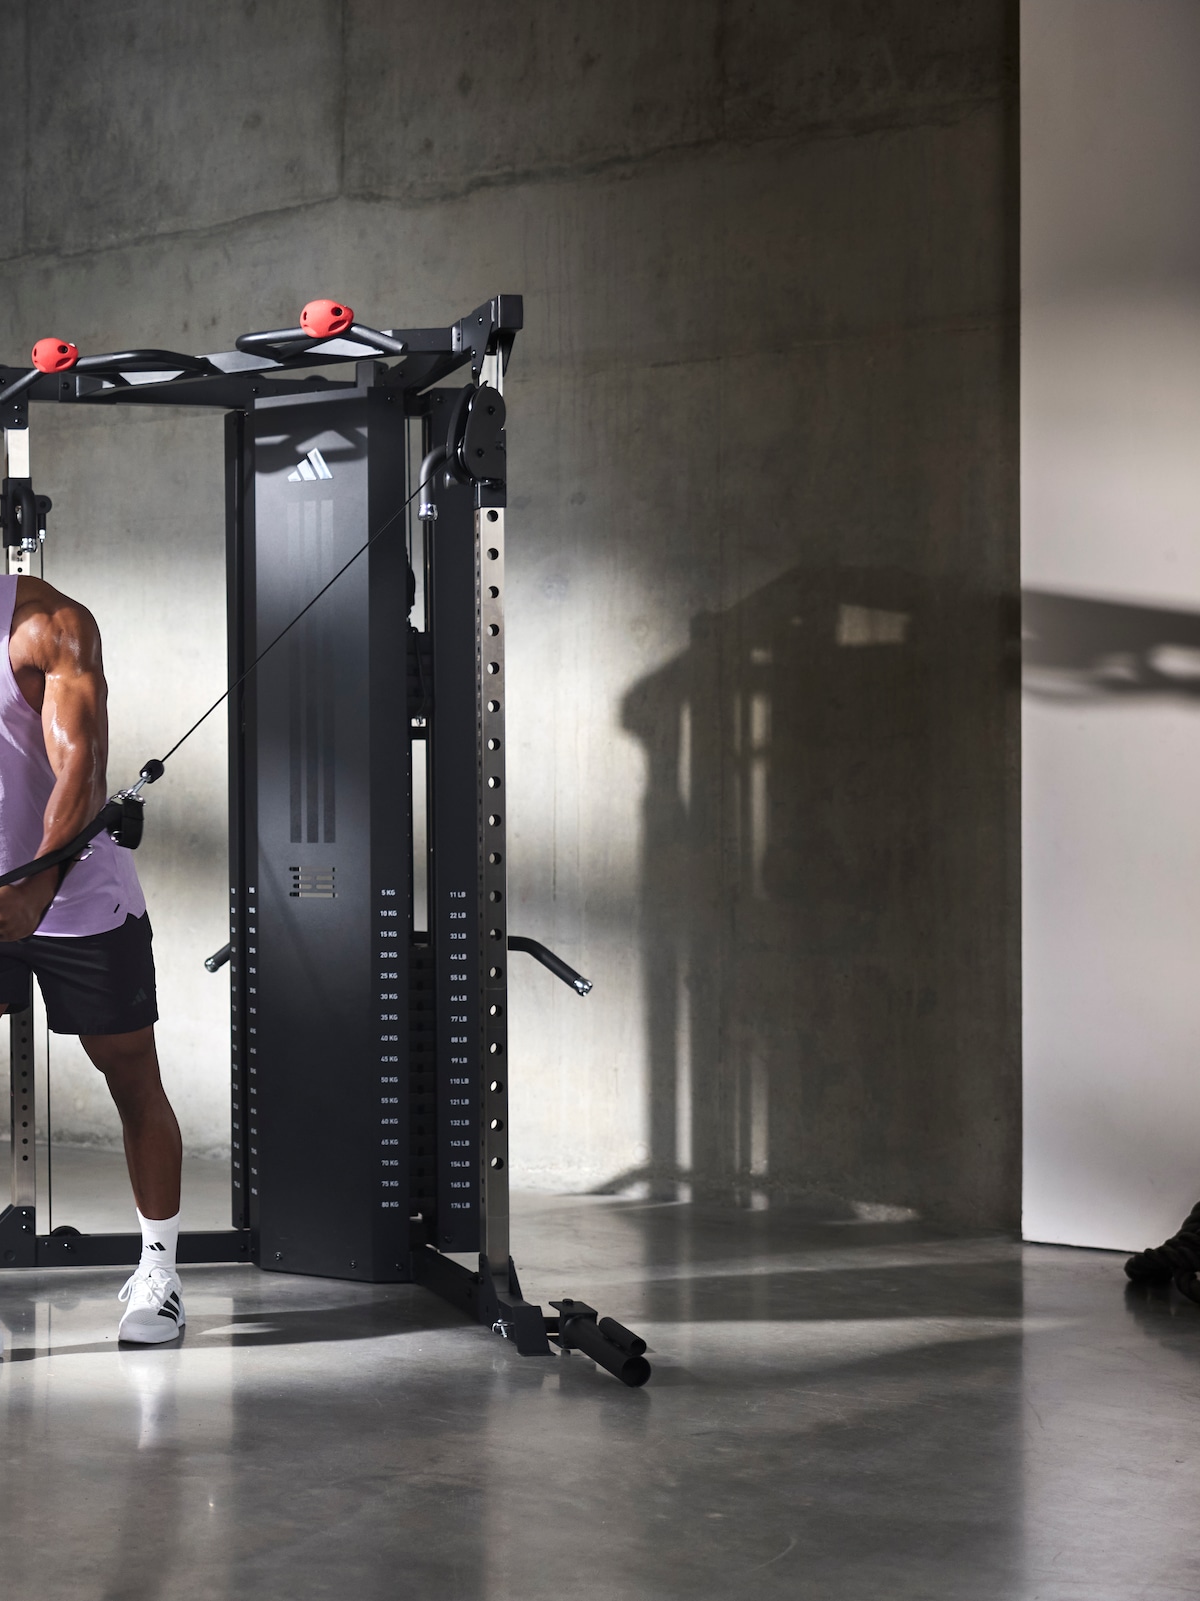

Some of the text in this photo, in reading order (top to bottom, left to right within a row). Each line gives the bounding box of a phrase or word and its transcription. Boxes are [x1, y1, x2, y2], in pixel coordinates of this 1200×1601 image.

[387, 888, 396, 897] KG
[449, 891, 467, 899] 11 LB
[380, 909, 398, 917] 10 KG
[449, 911, 467, 920] 22 LB
[380, 930, 398, 938] 15 KG
[449, 932, 467, 940] 33 LB
[380, 951, 398, 959] 20 KG
[449, 953, 467, 961] 44 LB
[380, 972, 398, 980] 25 KG
[450, 973, 467, 982] 55 LB
[380, 992, 398, 1001] 30 KG
[450, 994, 468, 1002] 66 LB
[380, 1013, 398, 1021] 35 KG
[450, 1015, 468, 1023] 77 LB
[380, 1034, 398, 1042] 40 KG
[450, 1036, 468, 1044] 88 LB
[380, 1055, 399, 1063] 45 KG
[450, 1056, 468, 1064] 99 LB
[380, 1076, 399, 1084] 50 KG
[450, 1077, 470, 1085] 110 LB
[450, 1098, 470, 1106] 121 LB
[381, 1117, 399, 1125] 60 KG
[450, 1119, 470, 1127] 132 LB
[381, 1138, 399, 1146] 65 KG
[450, 1139, 470, 1147] 143 LB
[381, 1159, 399, 1167] 70 KG
[450, 1160, 470, 1168] 154 LB
[381, 1180, 399, 1188] 75 KG
[450, 1181, 470, 1189] 165 LB
